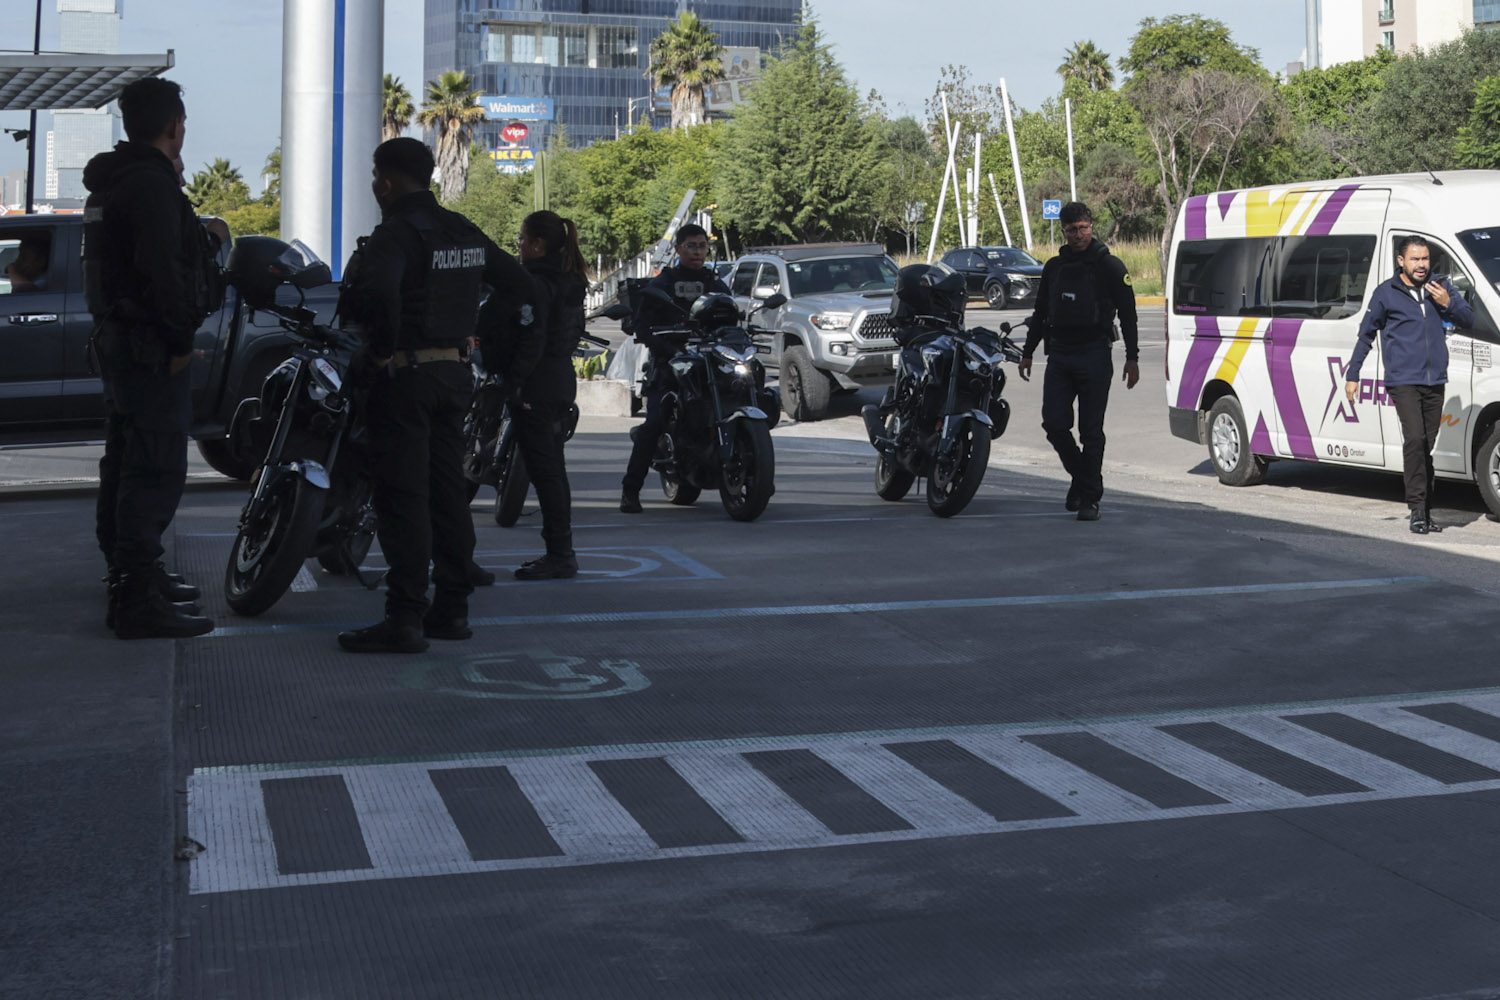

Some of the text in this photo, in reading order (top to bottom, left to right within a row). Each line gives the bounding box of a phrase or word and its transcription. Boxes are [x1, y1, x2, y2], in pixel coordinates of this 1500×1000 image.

[489, 102, 535, 114] Walmart
[506, 128, 525, 138] vips
[489, 150, 534, 160] IKEA
